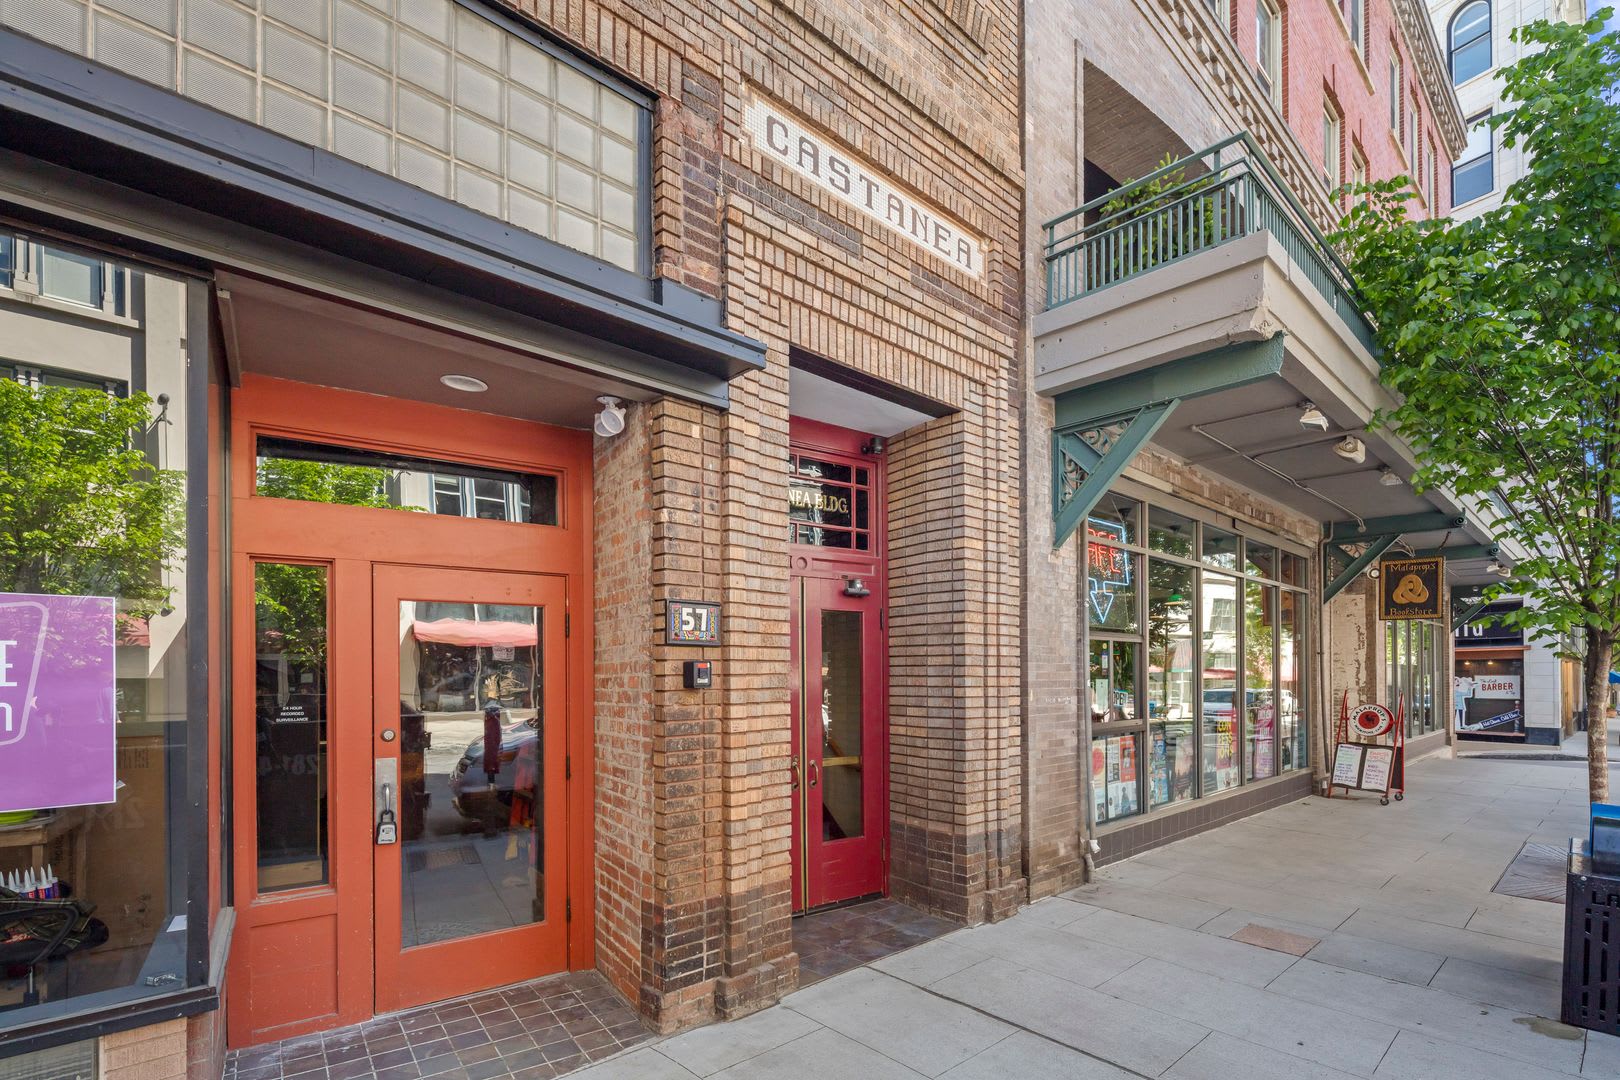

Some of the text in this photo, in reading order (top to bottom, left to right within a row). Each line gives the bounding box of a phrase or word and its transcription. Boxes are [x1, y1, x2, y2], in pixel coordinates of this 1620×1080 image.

[765, 114, 973, 271] CASTANEA
[814, 493, 849, 514] BLDG.
[681, 607, 708, 631] 57
[1481, 682, 1514, 691] BARBER
